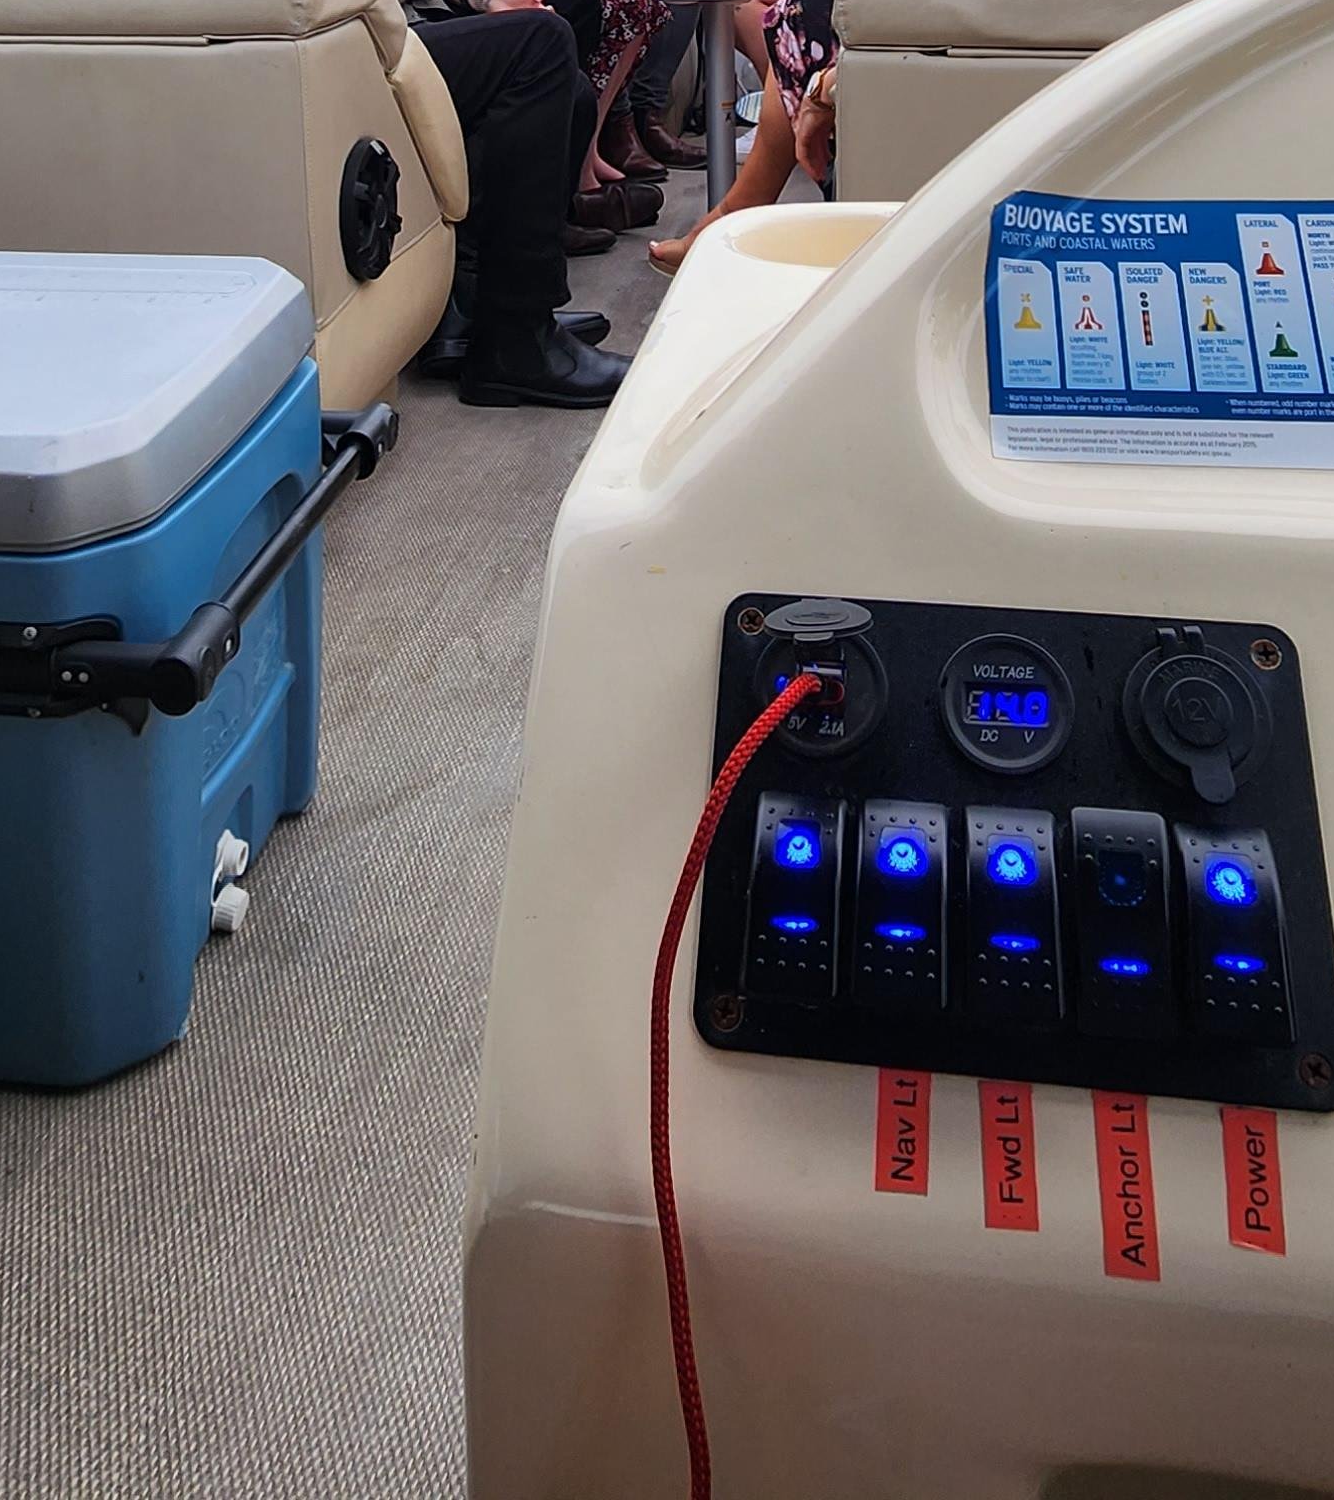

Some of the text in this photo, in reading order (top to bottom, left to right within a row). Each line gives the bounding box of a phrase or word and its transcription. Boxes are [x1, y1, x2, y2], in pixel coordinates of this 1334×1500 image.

[1004, 204, 1188, 235] BUOYAGE SYSTEM
[1244, 219, 1278, 228] LATERAL
[1001, 230, 1155, 251] PORTS AND COASTAL WATERS
[1003, 264, 1034, 274] SPECIAL
[1064, 266, 1083, 275] SAFE
[1125, 267, 1163, 276] ISOLATED
[1189, 267, 1207, 276] NEW
[1065, 275, 1091, 284] WATER
[1126, 276, 1158, 285] DANGER
[1189, 276, 1227, 285] DANGERS
[973, 664, 1036, 680] VOLTAGE
[1158, 660, 1222, 685] MARINE
[787, 715, 808, 731] 5V
[818, 720, 845, 737] 2.1A
[980, 729, 999, 742] DC
[1024, 731, 1035, 743] V
[890, 1078, 918, 1182] Nav Lt
[995, 1094, 1025, 1205] Fwd Lt
[1111, 1102, 1146, 1267] Anchor Lt
[1244, 1124, 1271, 1232] Power
